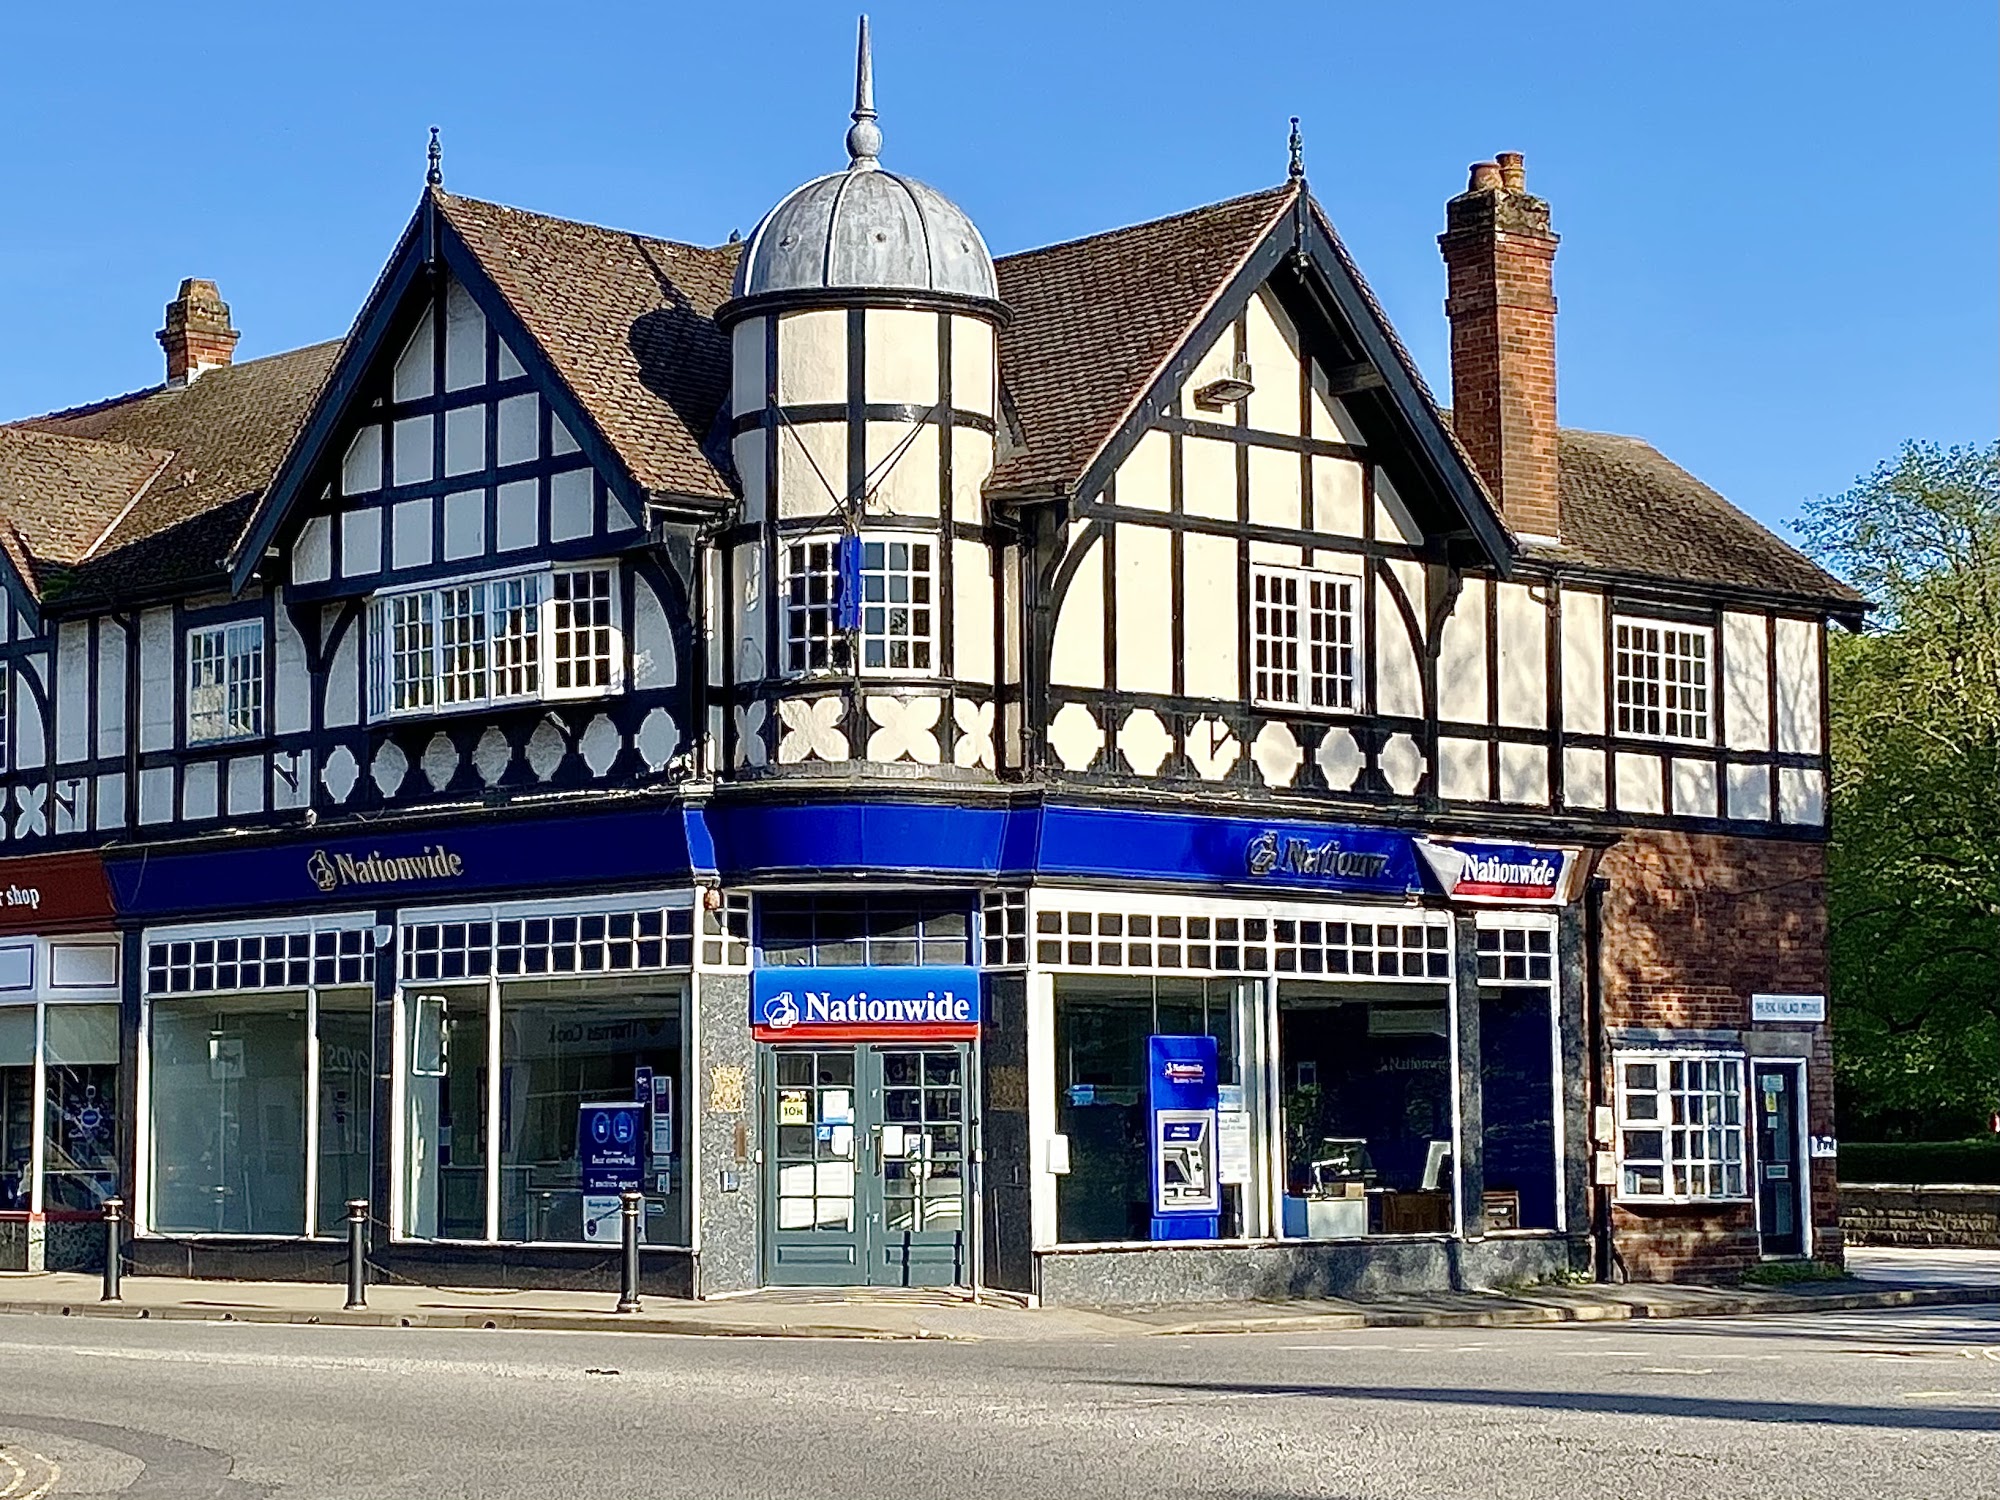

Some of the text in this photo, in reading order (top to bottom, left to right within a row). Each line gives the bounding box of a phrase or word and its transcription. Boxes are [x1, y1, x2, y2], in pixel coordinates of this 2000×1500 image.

[333, 844, 464, 885] Nationwide
[1462, 854, 1555, 886] Nationwide
[6, 884, 40, 910] shop
[804, 991, 971, 1022] Nationwide
